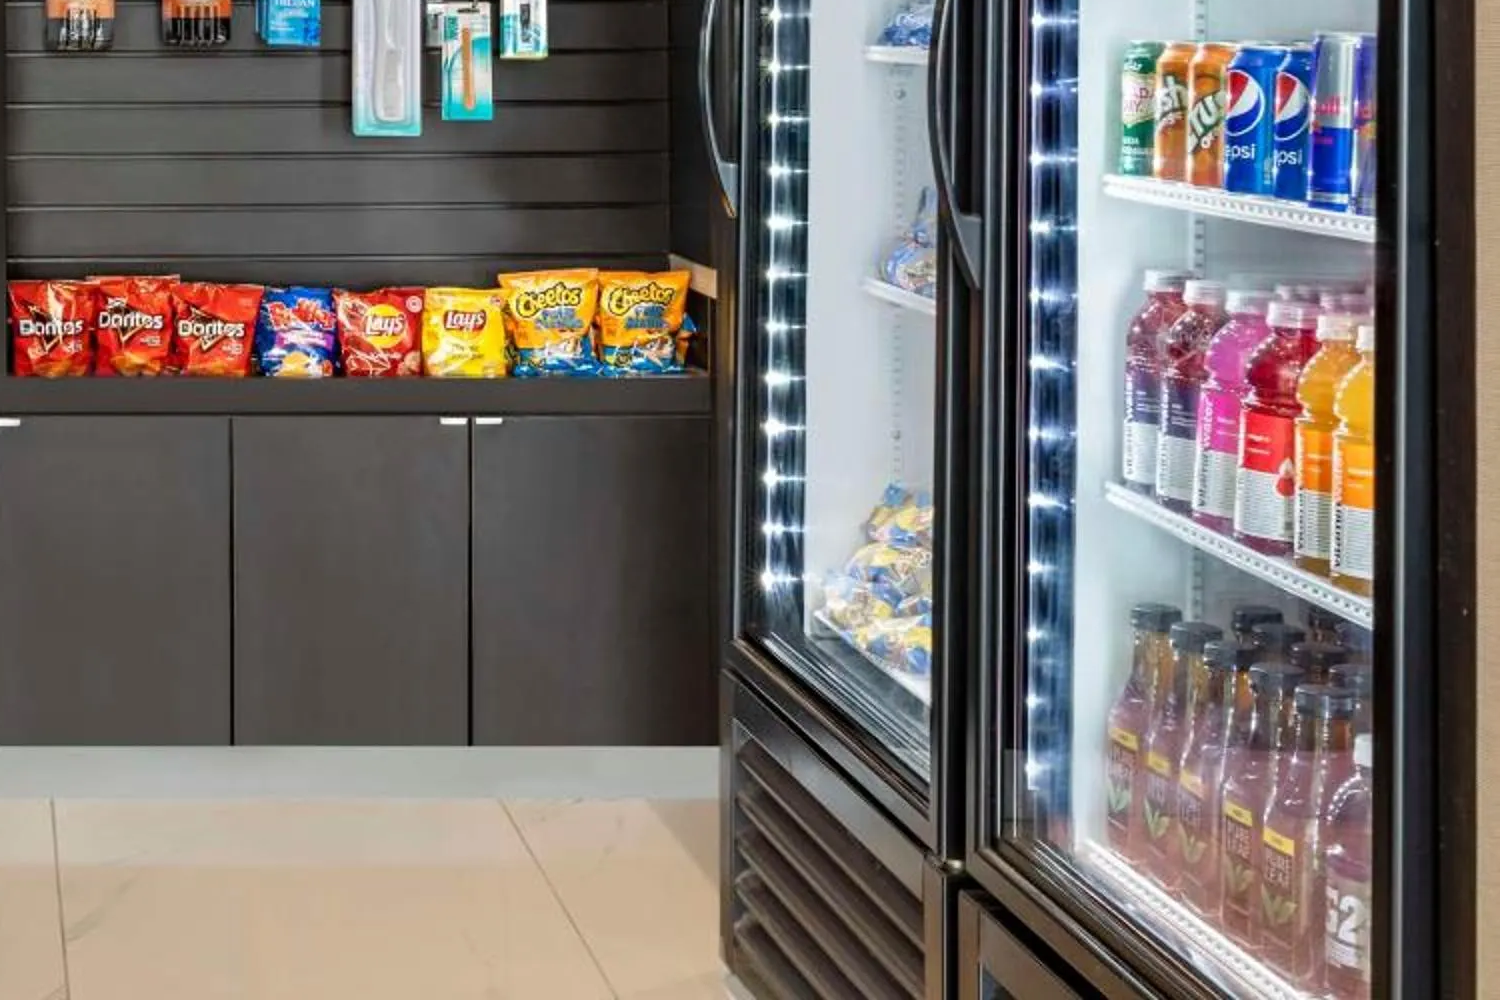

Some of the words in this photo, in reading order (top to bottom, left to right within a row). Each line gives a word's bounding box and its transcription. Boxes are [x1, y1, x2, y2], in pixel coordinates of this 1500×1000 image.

[1225, 143, 1256, 160] epsi
[1277, 149, 1303, 166] psi
[516, 281, 583, 318] Cheetos
[608, 281, 676, 317] Cheetos
[19, 318, 84, 337] Doritos
[98, 310, 164, 329] Doritos
[177, 319, 245, 337] Doritos
